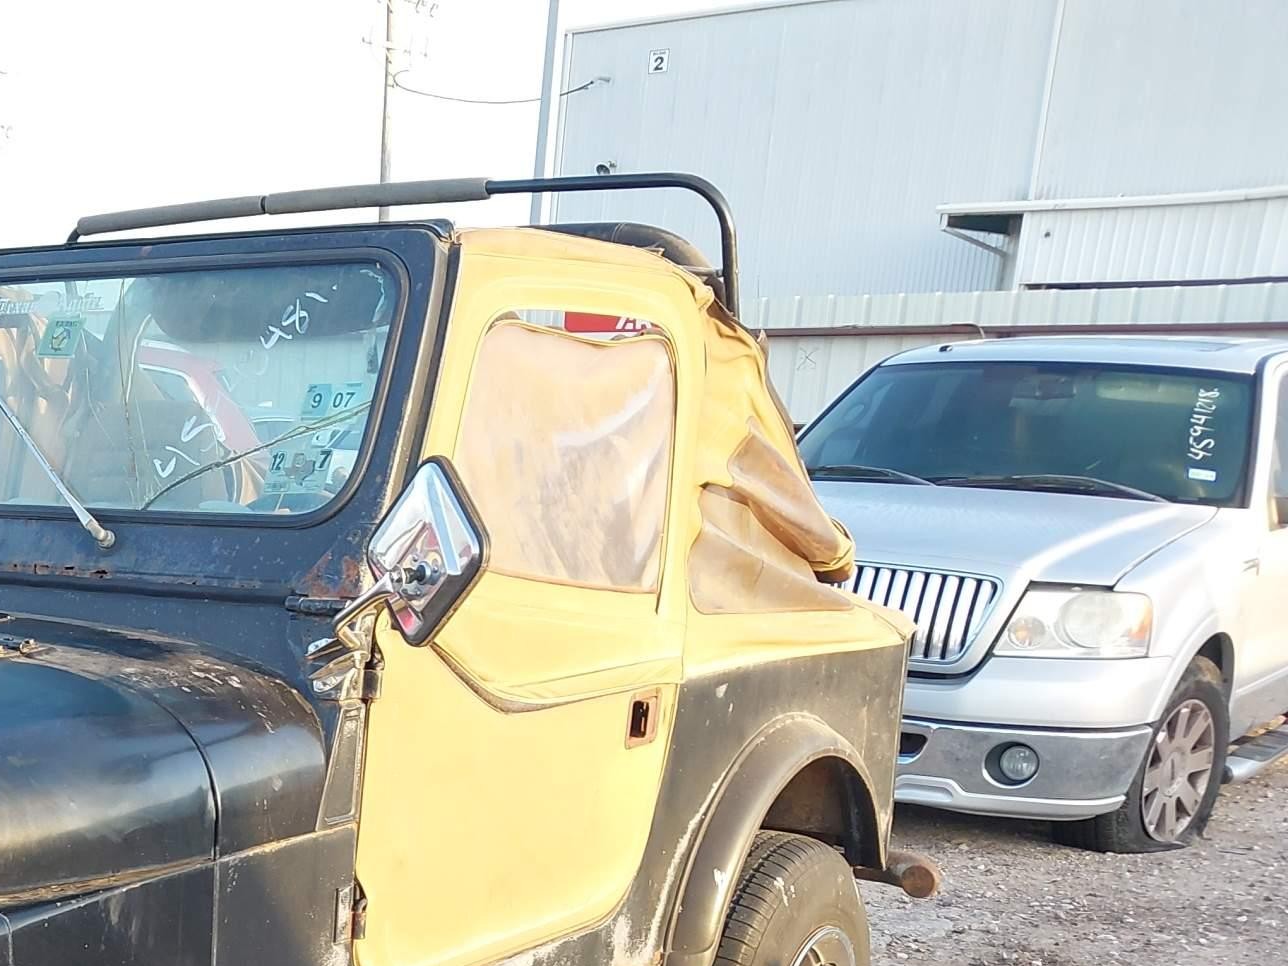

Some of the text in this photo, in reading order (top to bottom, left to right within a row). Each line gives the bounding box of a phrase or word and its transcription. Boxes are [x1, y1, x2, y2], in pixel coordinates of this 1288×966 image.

[653, 56, 665, 71] 2
[311, 391, 356, 409] 9 07
[1186, 388, 1221, 461] 45941218
[270, 452, 285, 471] 12
